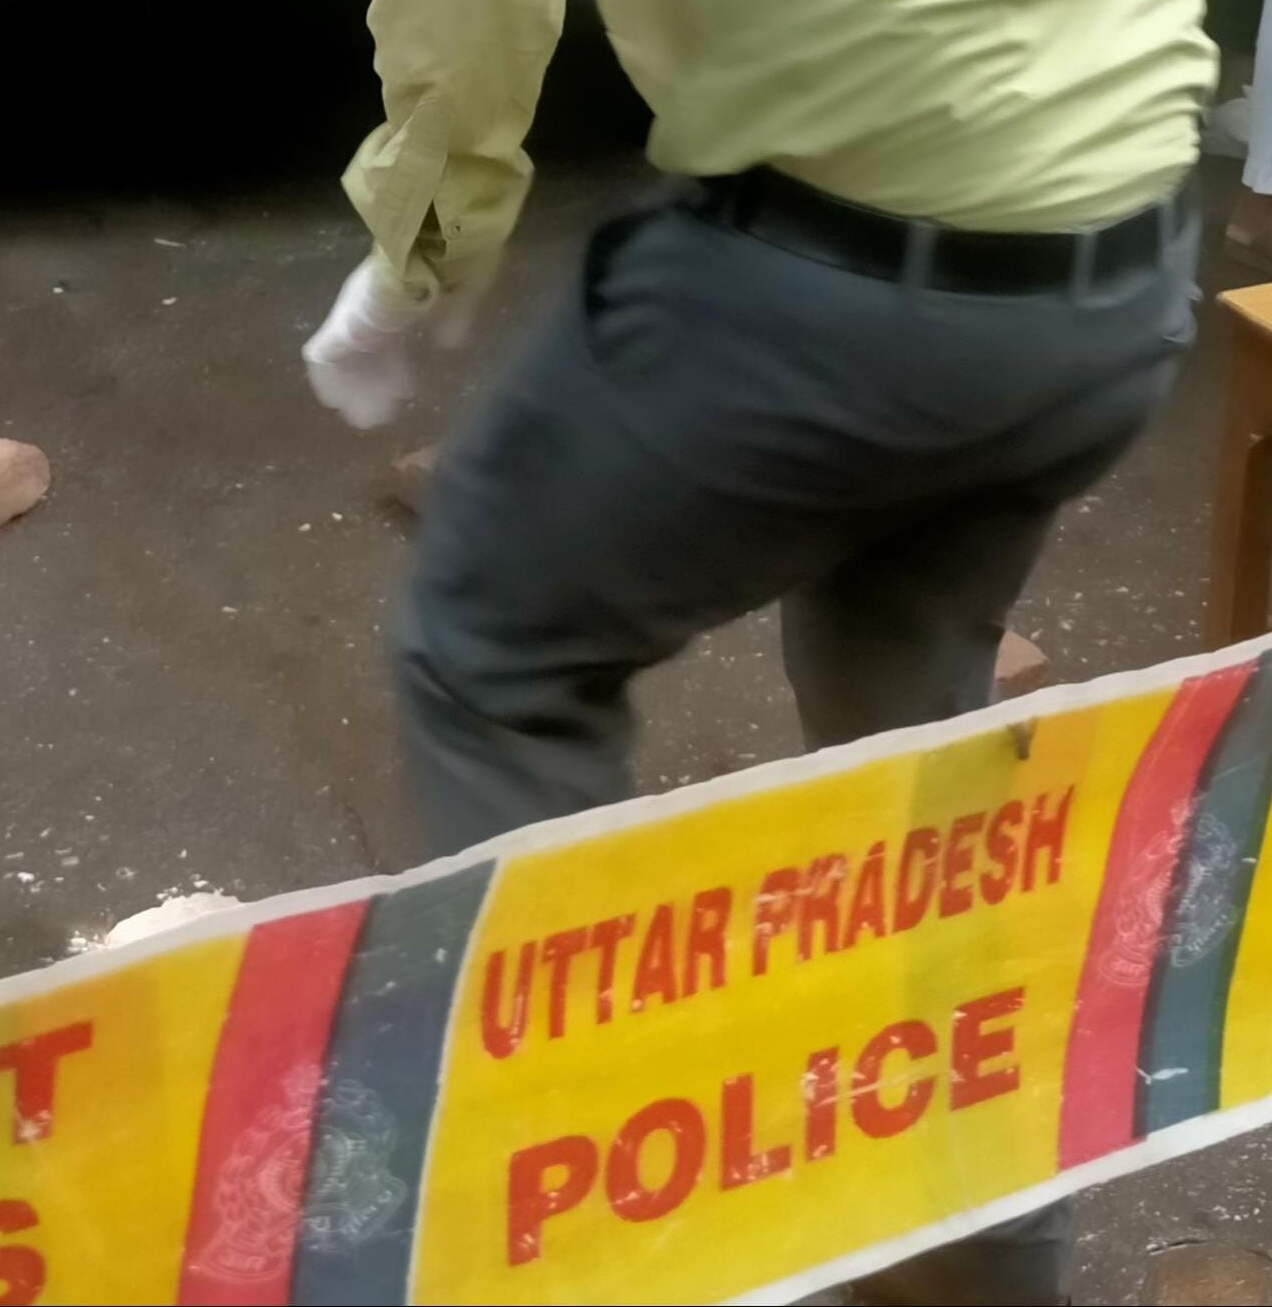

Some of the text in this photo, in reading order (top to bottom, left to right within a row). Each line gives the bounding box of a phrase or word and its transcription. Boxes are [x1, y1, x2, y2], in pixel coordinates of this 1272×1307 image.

[479, 784, 1076, 1061] UTTAR PRADESH
[506, 987, 1027, 1268] POLICE
